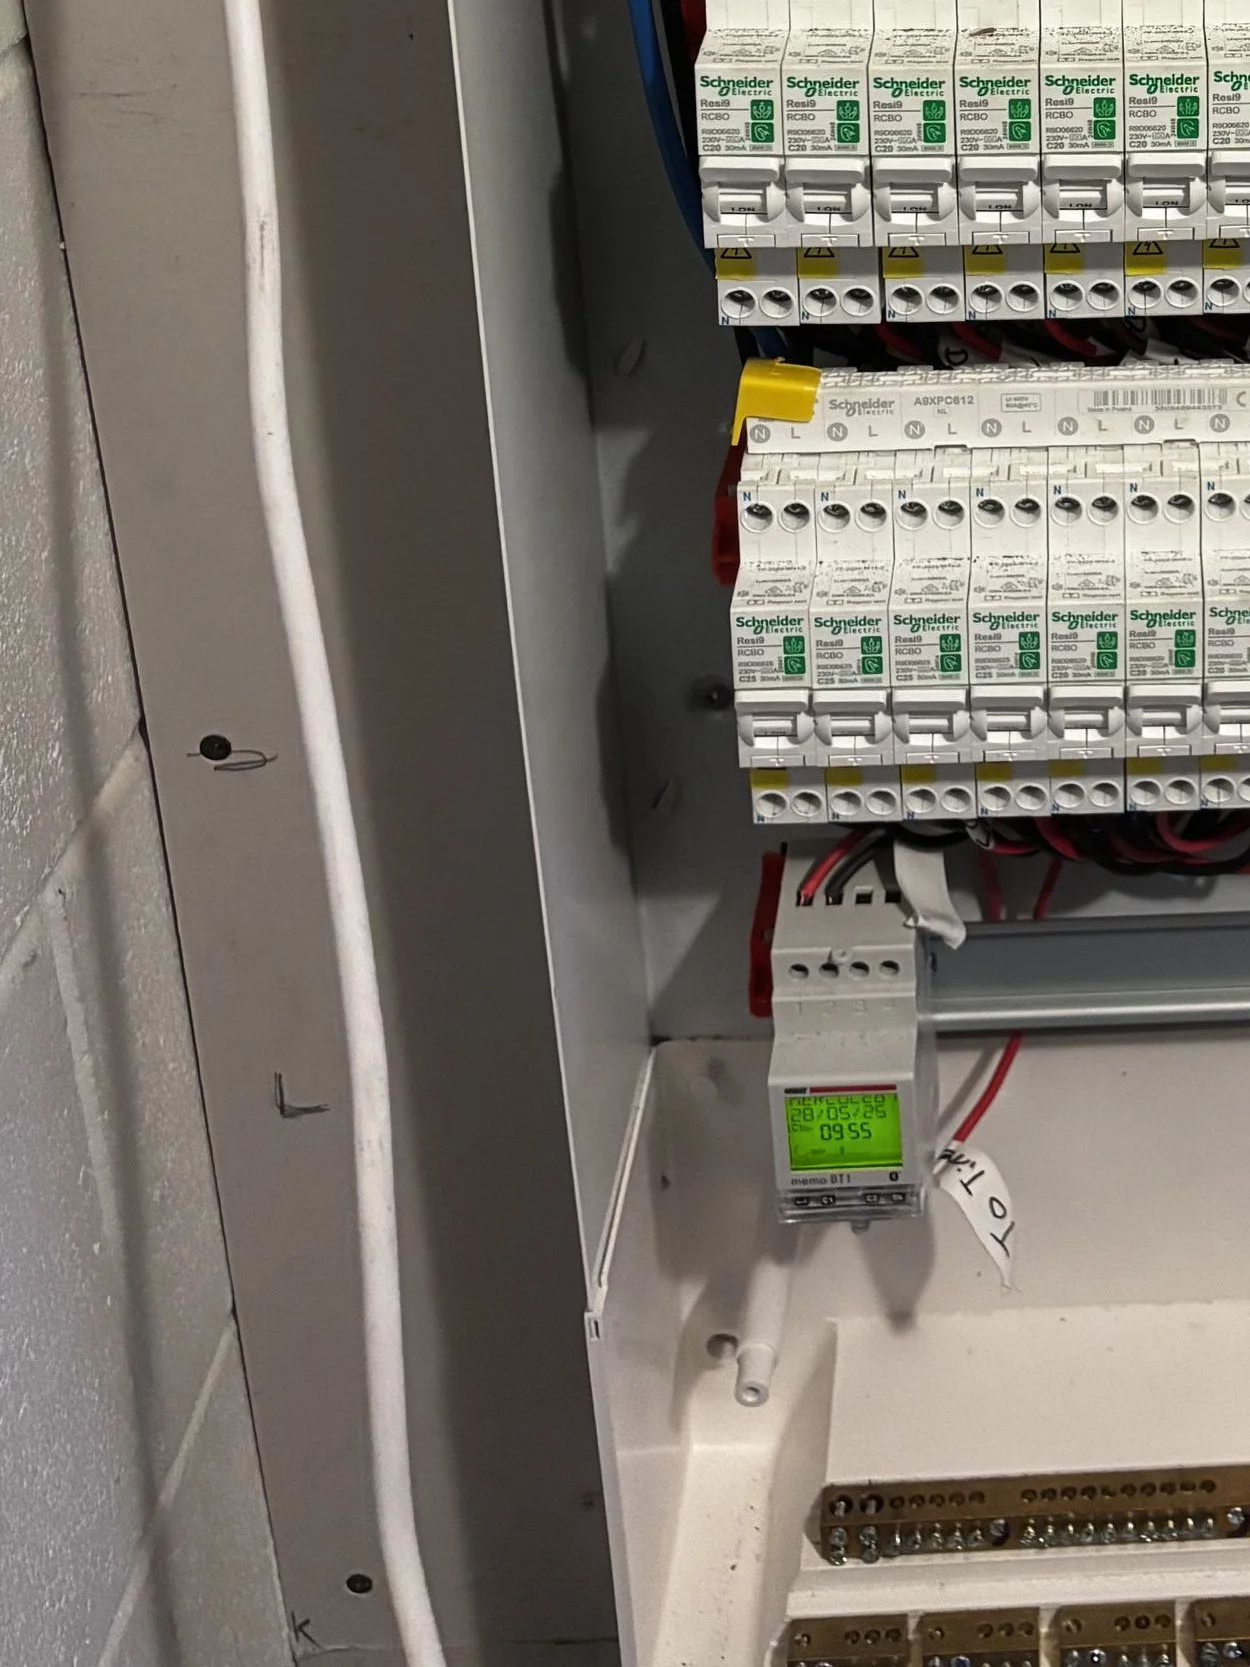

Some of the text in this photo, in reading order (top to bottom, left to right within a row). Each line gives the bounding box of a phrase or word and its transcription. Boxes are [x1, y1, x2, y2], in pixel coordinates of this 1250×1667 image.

[700, 76, 773, 93] Schneider
[786, 76, 859, 94] Schneider
[873, 77, 946, 94] Schneider
[960, 76, 1032, 93] Schneider
[1046, 75, 1117, 92] Schneider
[1129, 73, 1200, 90] Schneider
[732, 88, 772, 96] Electric
[818, 89, 858, 97] Electric
[905, 89, 944, 97] Electric
[991, 88, 1030, 96] Electric
[700, 100, 730, 108] Resi9
[701, 113, 730, 121] RCBO
[829, 398, 894, 413] Schneider
[736, 616, 804, 631] Schneider
[814, 617, 881, 632] Schneider
[893, 614, 960, 629] Schneider
[973, 612, 1040, 627] Schneider
[1050, 612, 1117, 627] Schneider
[1129, 610, 1195, 625] Schneider
[791, 1176, 828, 1186] memo
